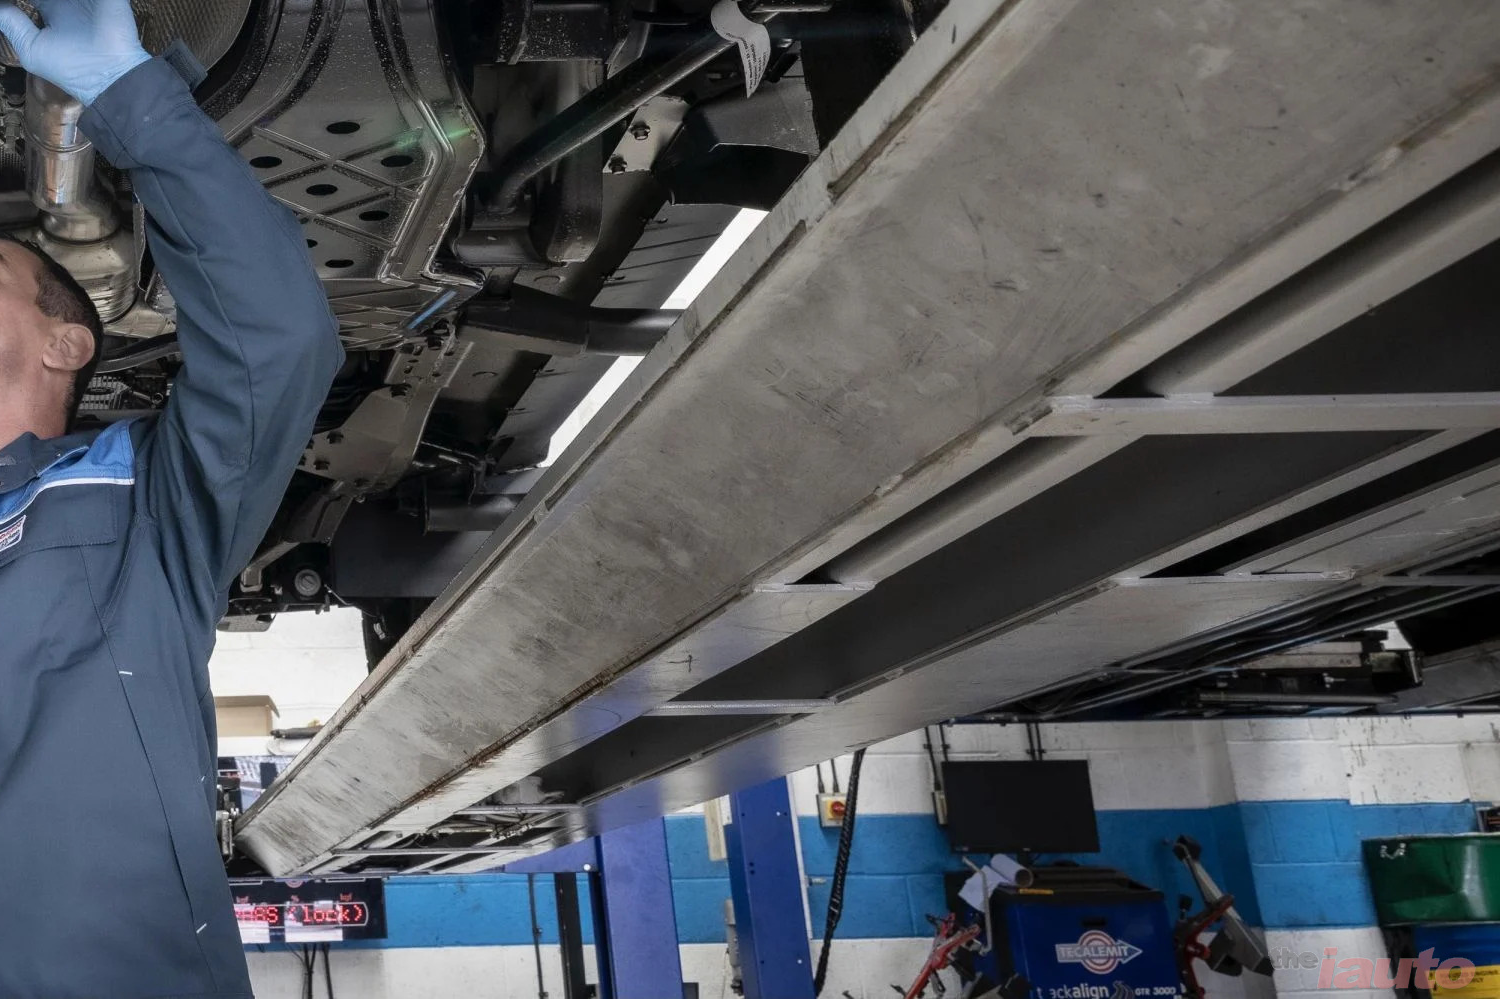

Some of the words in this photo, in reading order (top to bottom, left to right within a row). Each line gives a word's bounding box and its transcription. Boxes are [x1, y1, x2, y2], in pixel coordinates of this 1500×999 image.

[1059, 945, 1128, 958] TECALEMIT
[1135, 987, 1151, 996] GTR
[1152, 986, 1177, 996] 3000
